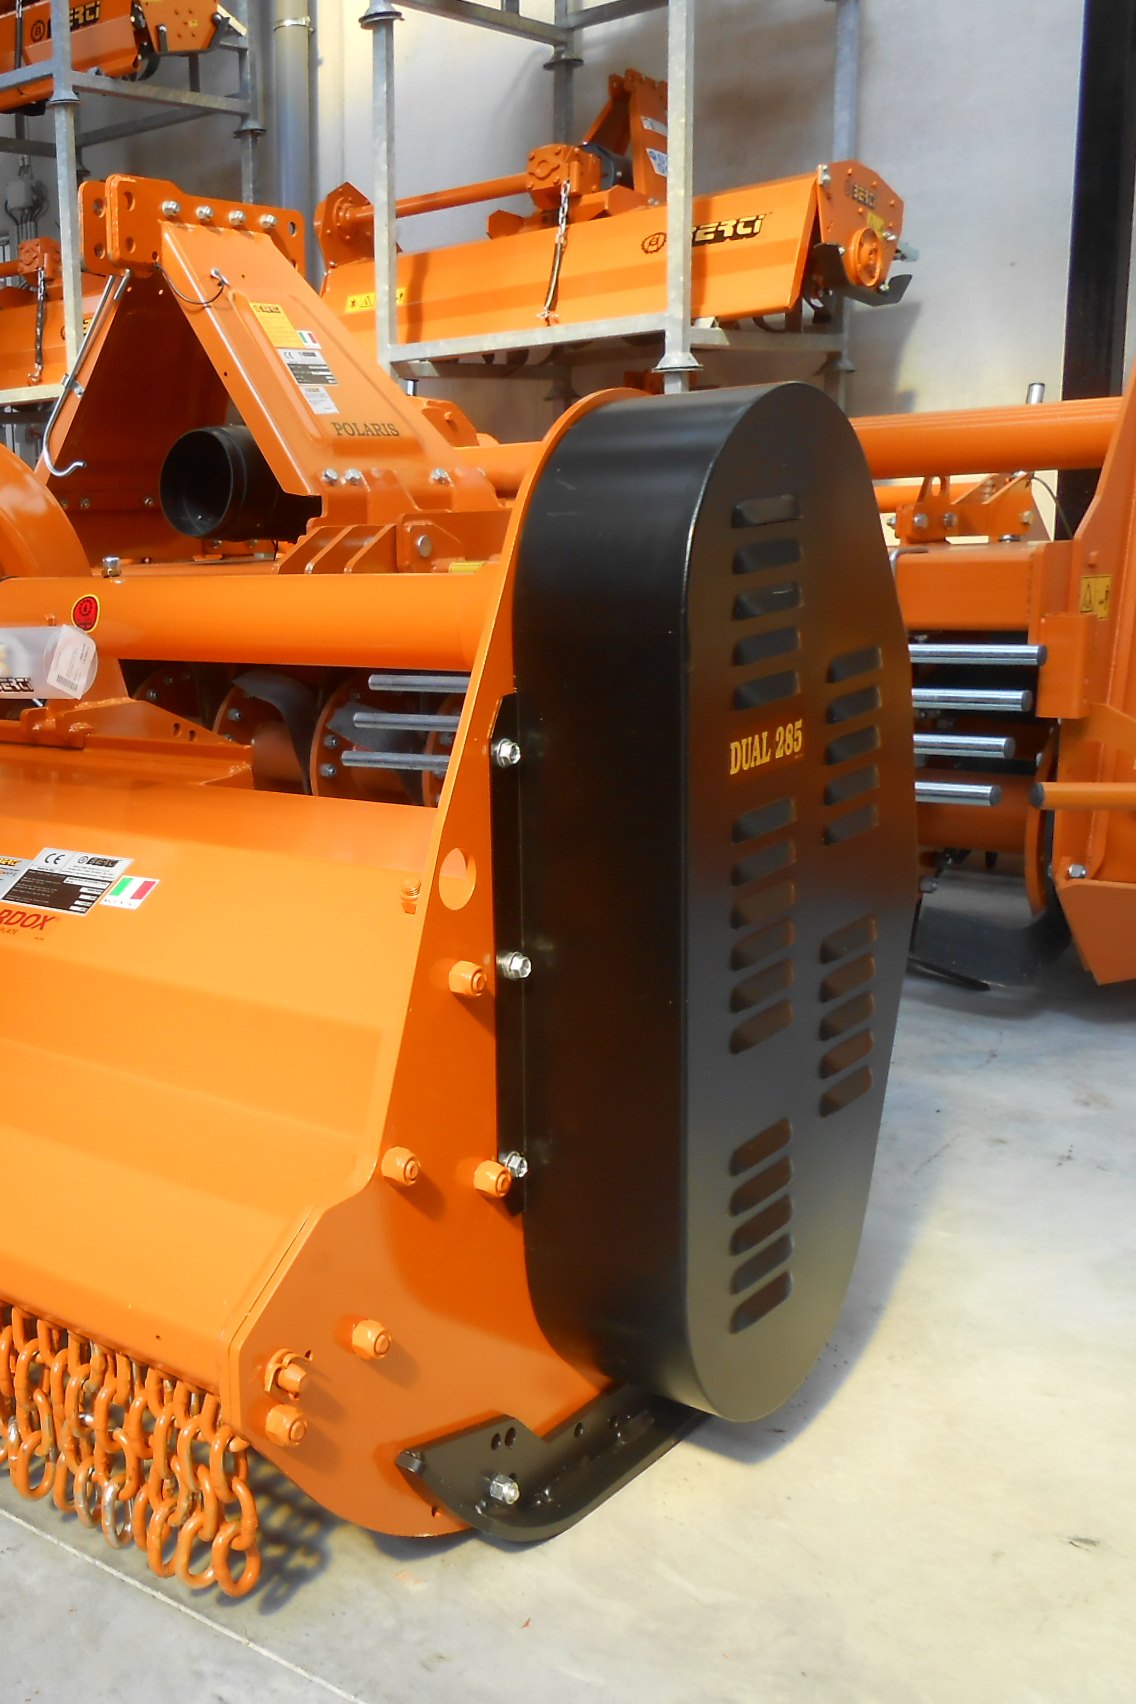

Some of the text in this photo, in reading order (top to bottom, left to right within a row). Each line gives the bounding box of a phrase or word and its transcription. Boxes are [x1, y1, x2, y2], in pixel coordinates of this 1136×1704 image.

[331, 422, 400, 437] POLARIS
[730, 718, 803, 775] DUAL 285
[44, 853, 66, 865] CE
